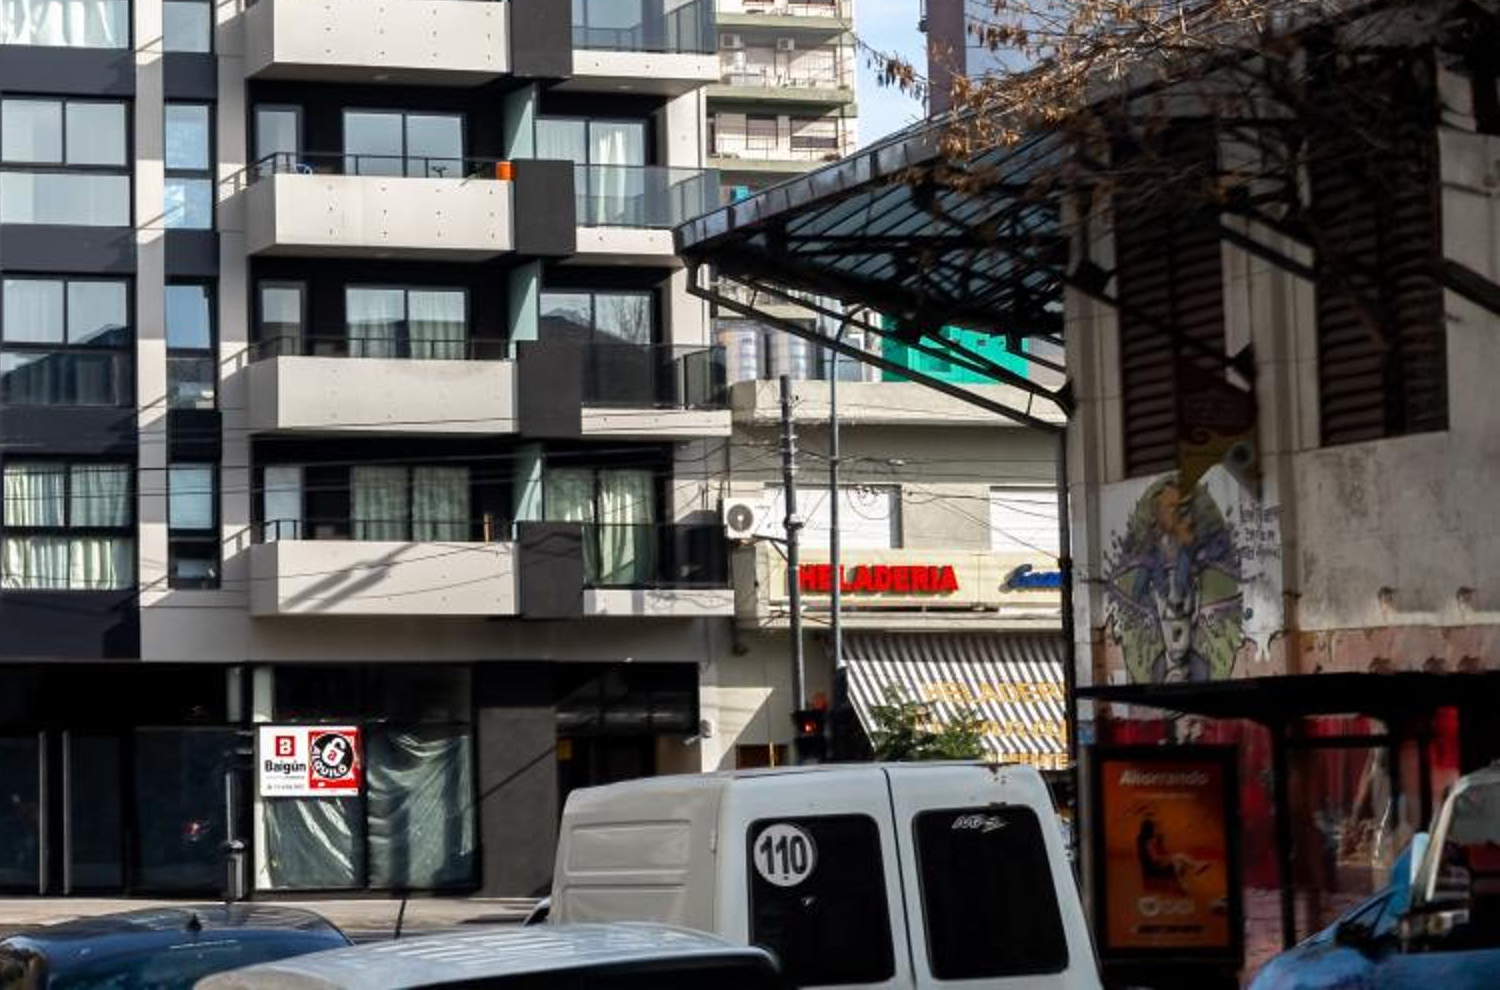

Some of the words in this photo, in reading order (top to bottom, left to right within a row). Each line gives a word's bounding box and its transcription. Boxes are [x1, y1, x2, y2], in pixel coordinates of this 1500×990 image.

[799, 563, 959, 595] HELADERIA
[265, 759, 307, 775] Baigún
[760, 835, 808, 875] 110
